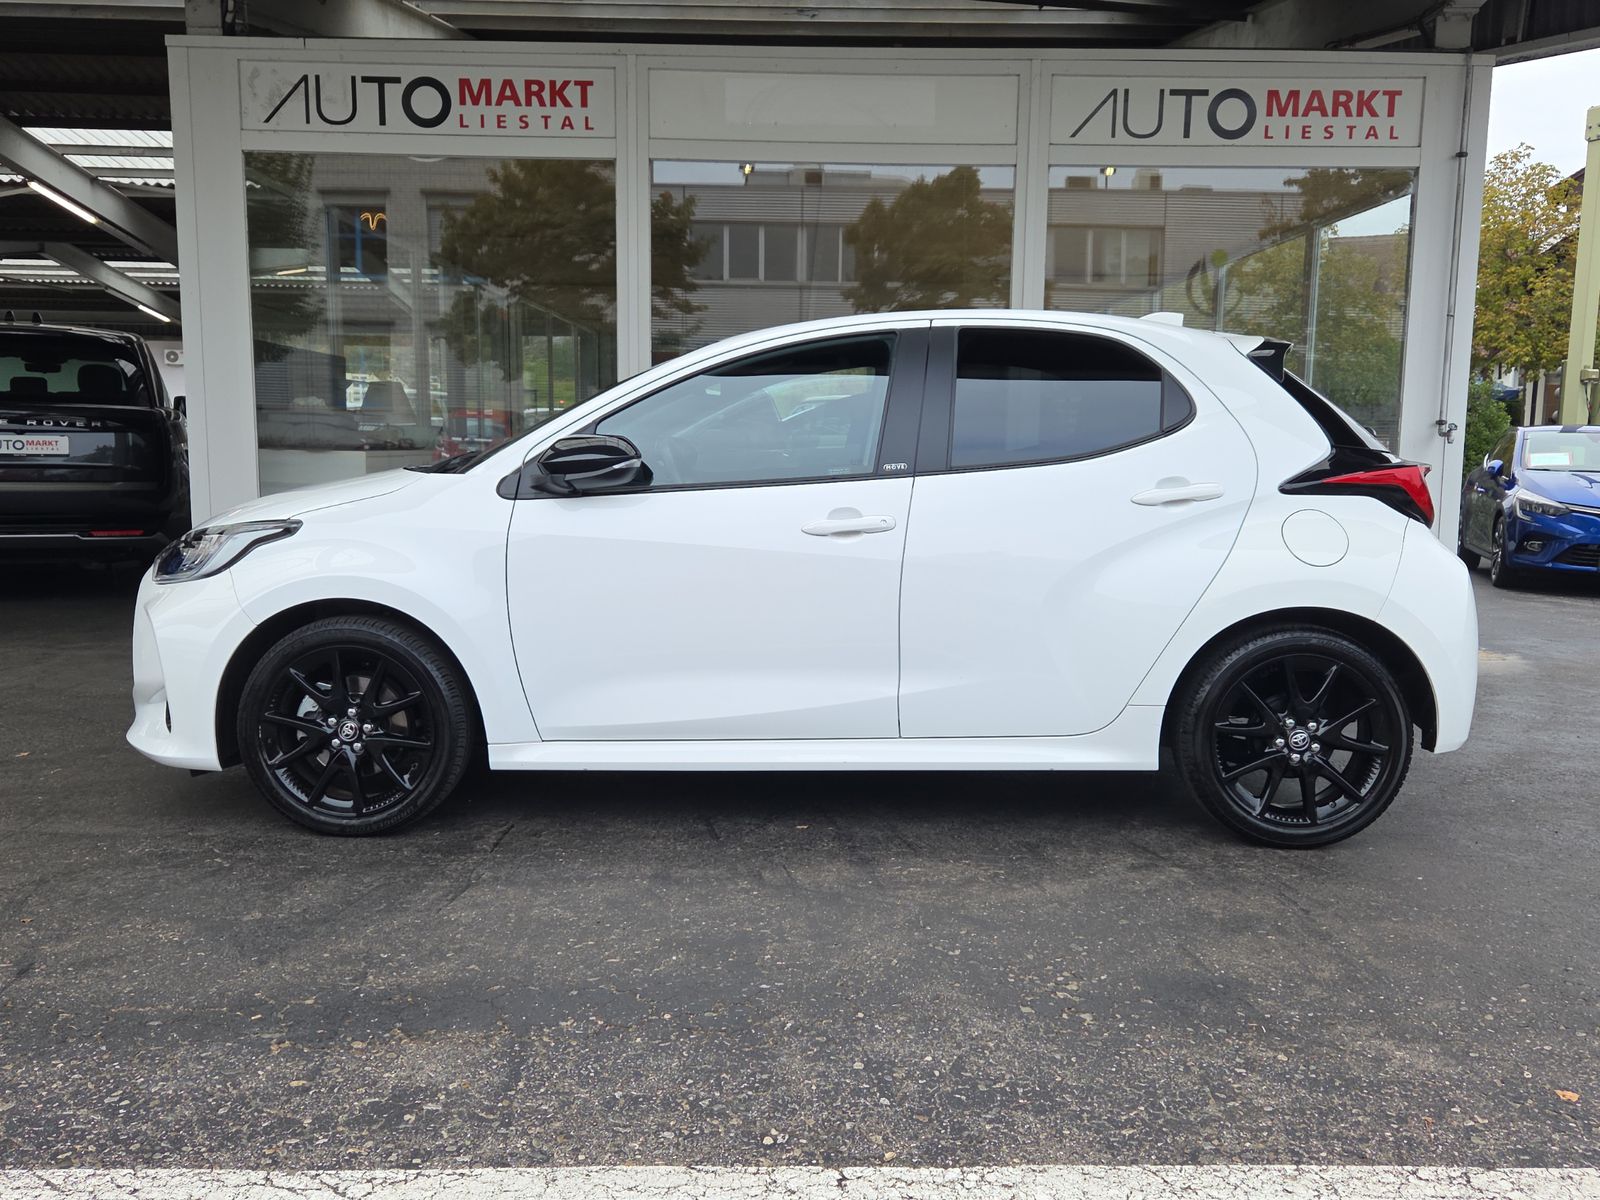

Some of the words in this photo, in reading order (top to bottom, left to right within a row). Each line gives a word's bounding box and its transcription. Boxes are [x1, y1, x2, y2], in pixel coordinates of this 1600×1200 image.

[263, 74, 452, 129] AUTO
[458, 78, 595, 109] MARKT
[458, 113, 595, 131] LIESTAL
[1069, 87, 1258, 140] AUTO
[1265, 89, 1404, 118] MARKT
[1263, 124, 1400, 140] LIESTAL
[26, 419, 101, 428] ROVER
